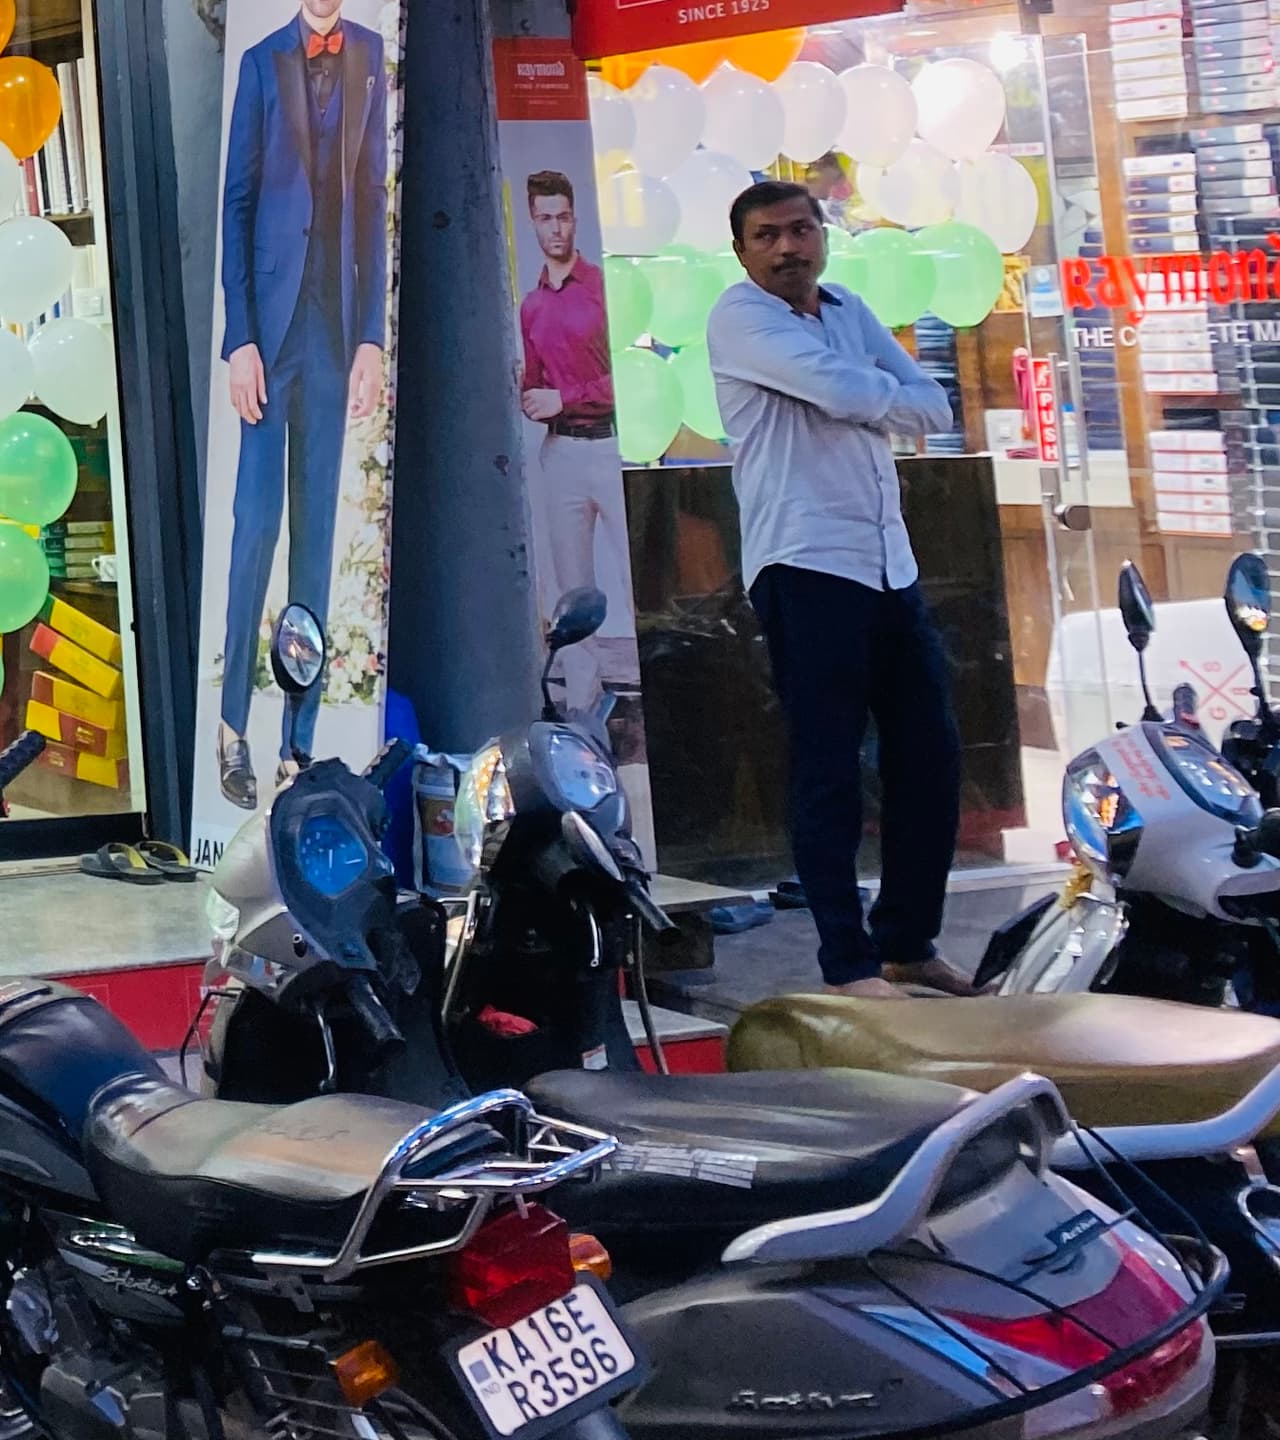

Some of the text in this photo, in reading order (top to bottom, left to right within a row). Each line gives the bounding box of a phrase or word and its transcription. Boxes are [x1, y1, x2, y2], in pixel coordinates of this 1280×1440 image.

[678, 2, 726, 25] SINCE
[1059, 232, 1280, 326] Raymon
[1069, 326, 1116, 348] THE
[1040, 392, 1059, 460] PUSH
[507, 1337, 619, 1423] R3596
